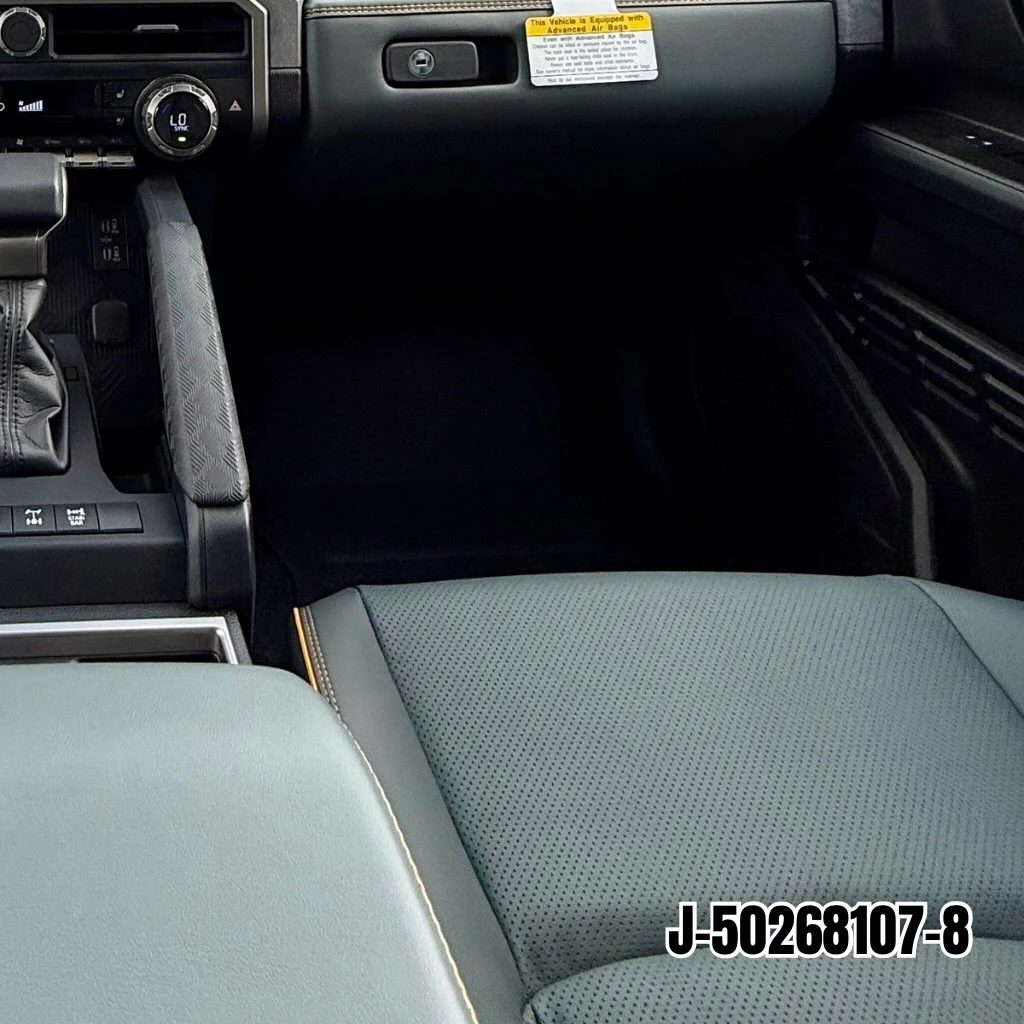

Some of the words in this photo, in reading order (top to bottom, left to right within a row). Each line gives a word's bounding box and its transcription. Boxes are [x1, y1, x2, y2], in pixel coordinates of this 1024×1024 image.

[590, 15, 624, 24] Equipped
[547, 25, 586, 33] Advanced
[608, 24, 628, 32] Bags
[170, 113, 187, 126] LO
